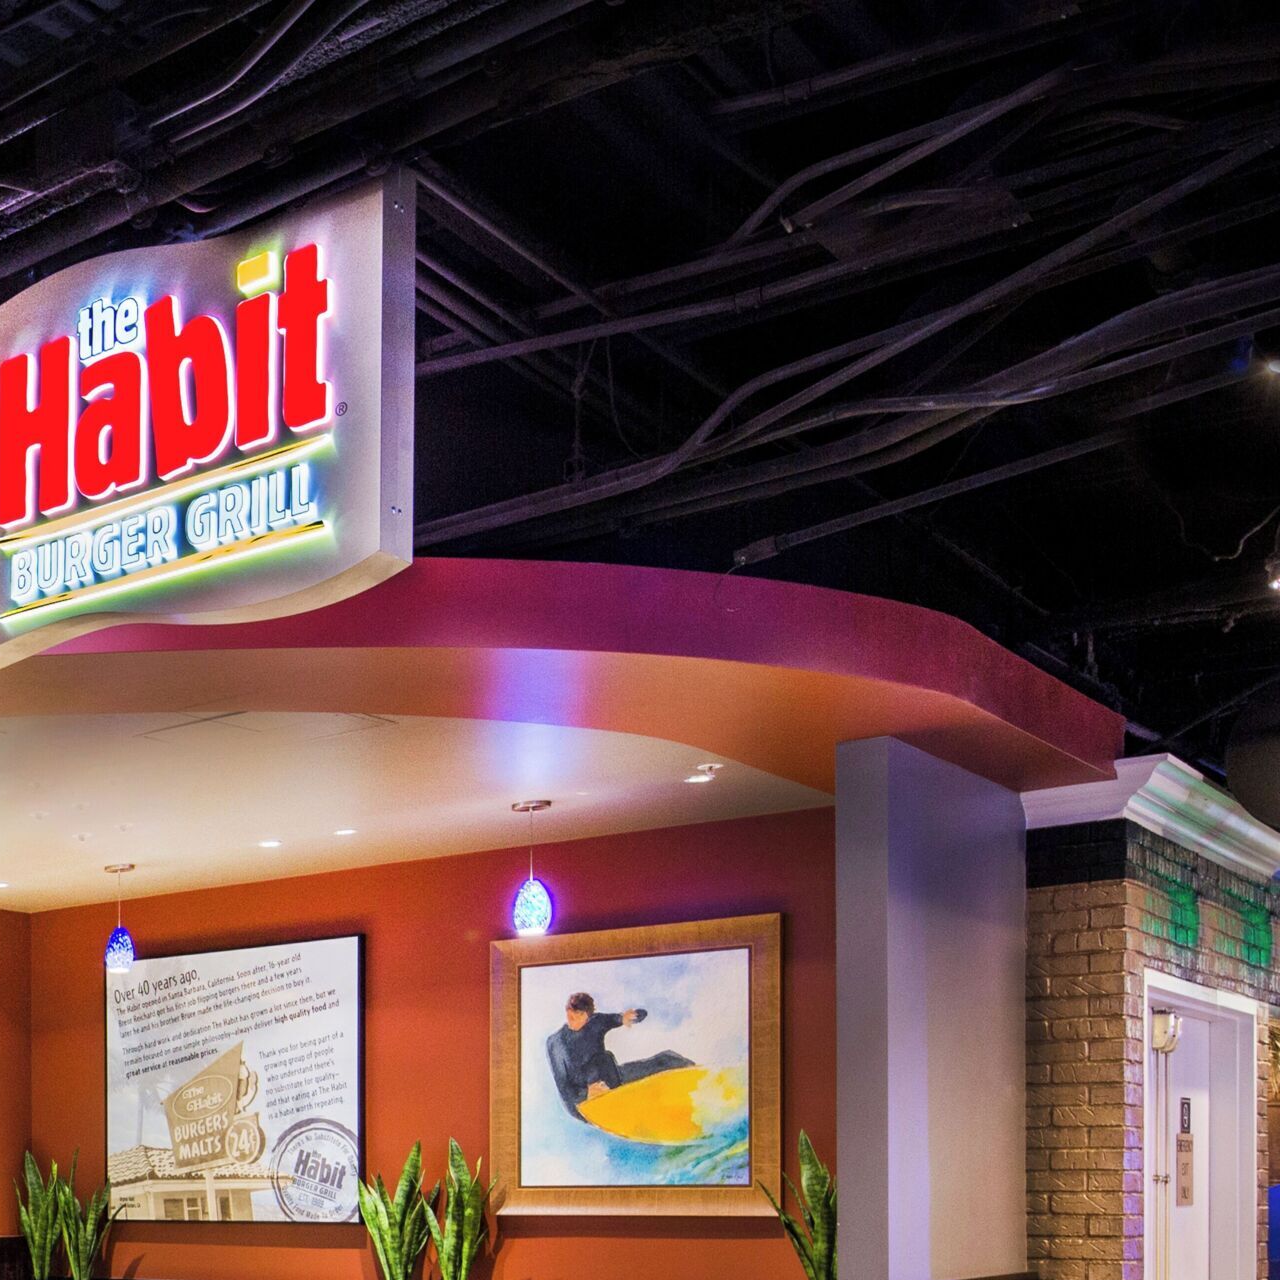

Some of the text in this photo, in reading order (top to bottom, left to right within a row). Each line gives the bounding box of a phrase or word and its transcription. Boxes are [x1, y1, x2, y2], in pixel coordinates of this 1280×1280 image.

[79, 295, 139, 364] the
[11, 463, 317, 604] BURGER GRILL
[114, 988, 135, 1004] Over
[138, 980, 150, 996] 40
[152, 976, 177, 996] years
[254, 1019, 273, 1030] deliver
[274, 1014, 288, 1024] high
[289, 1008, 310, 1021] quality
[312, 1003, 327, 1014] food
[329, 999, 339, 1010] and
[126, 1068, 140, 1079] great
[142, 1063, 161, 1074] service
[168, 1051, 199, 1066] reasonable
[174, 1112, 228, 1143] BURGERS
[180, 1136, 221, 1160] MALTS
[294, 1149, 346, 1189] Habit
[320, 1187, 337, 1199] GRILL
